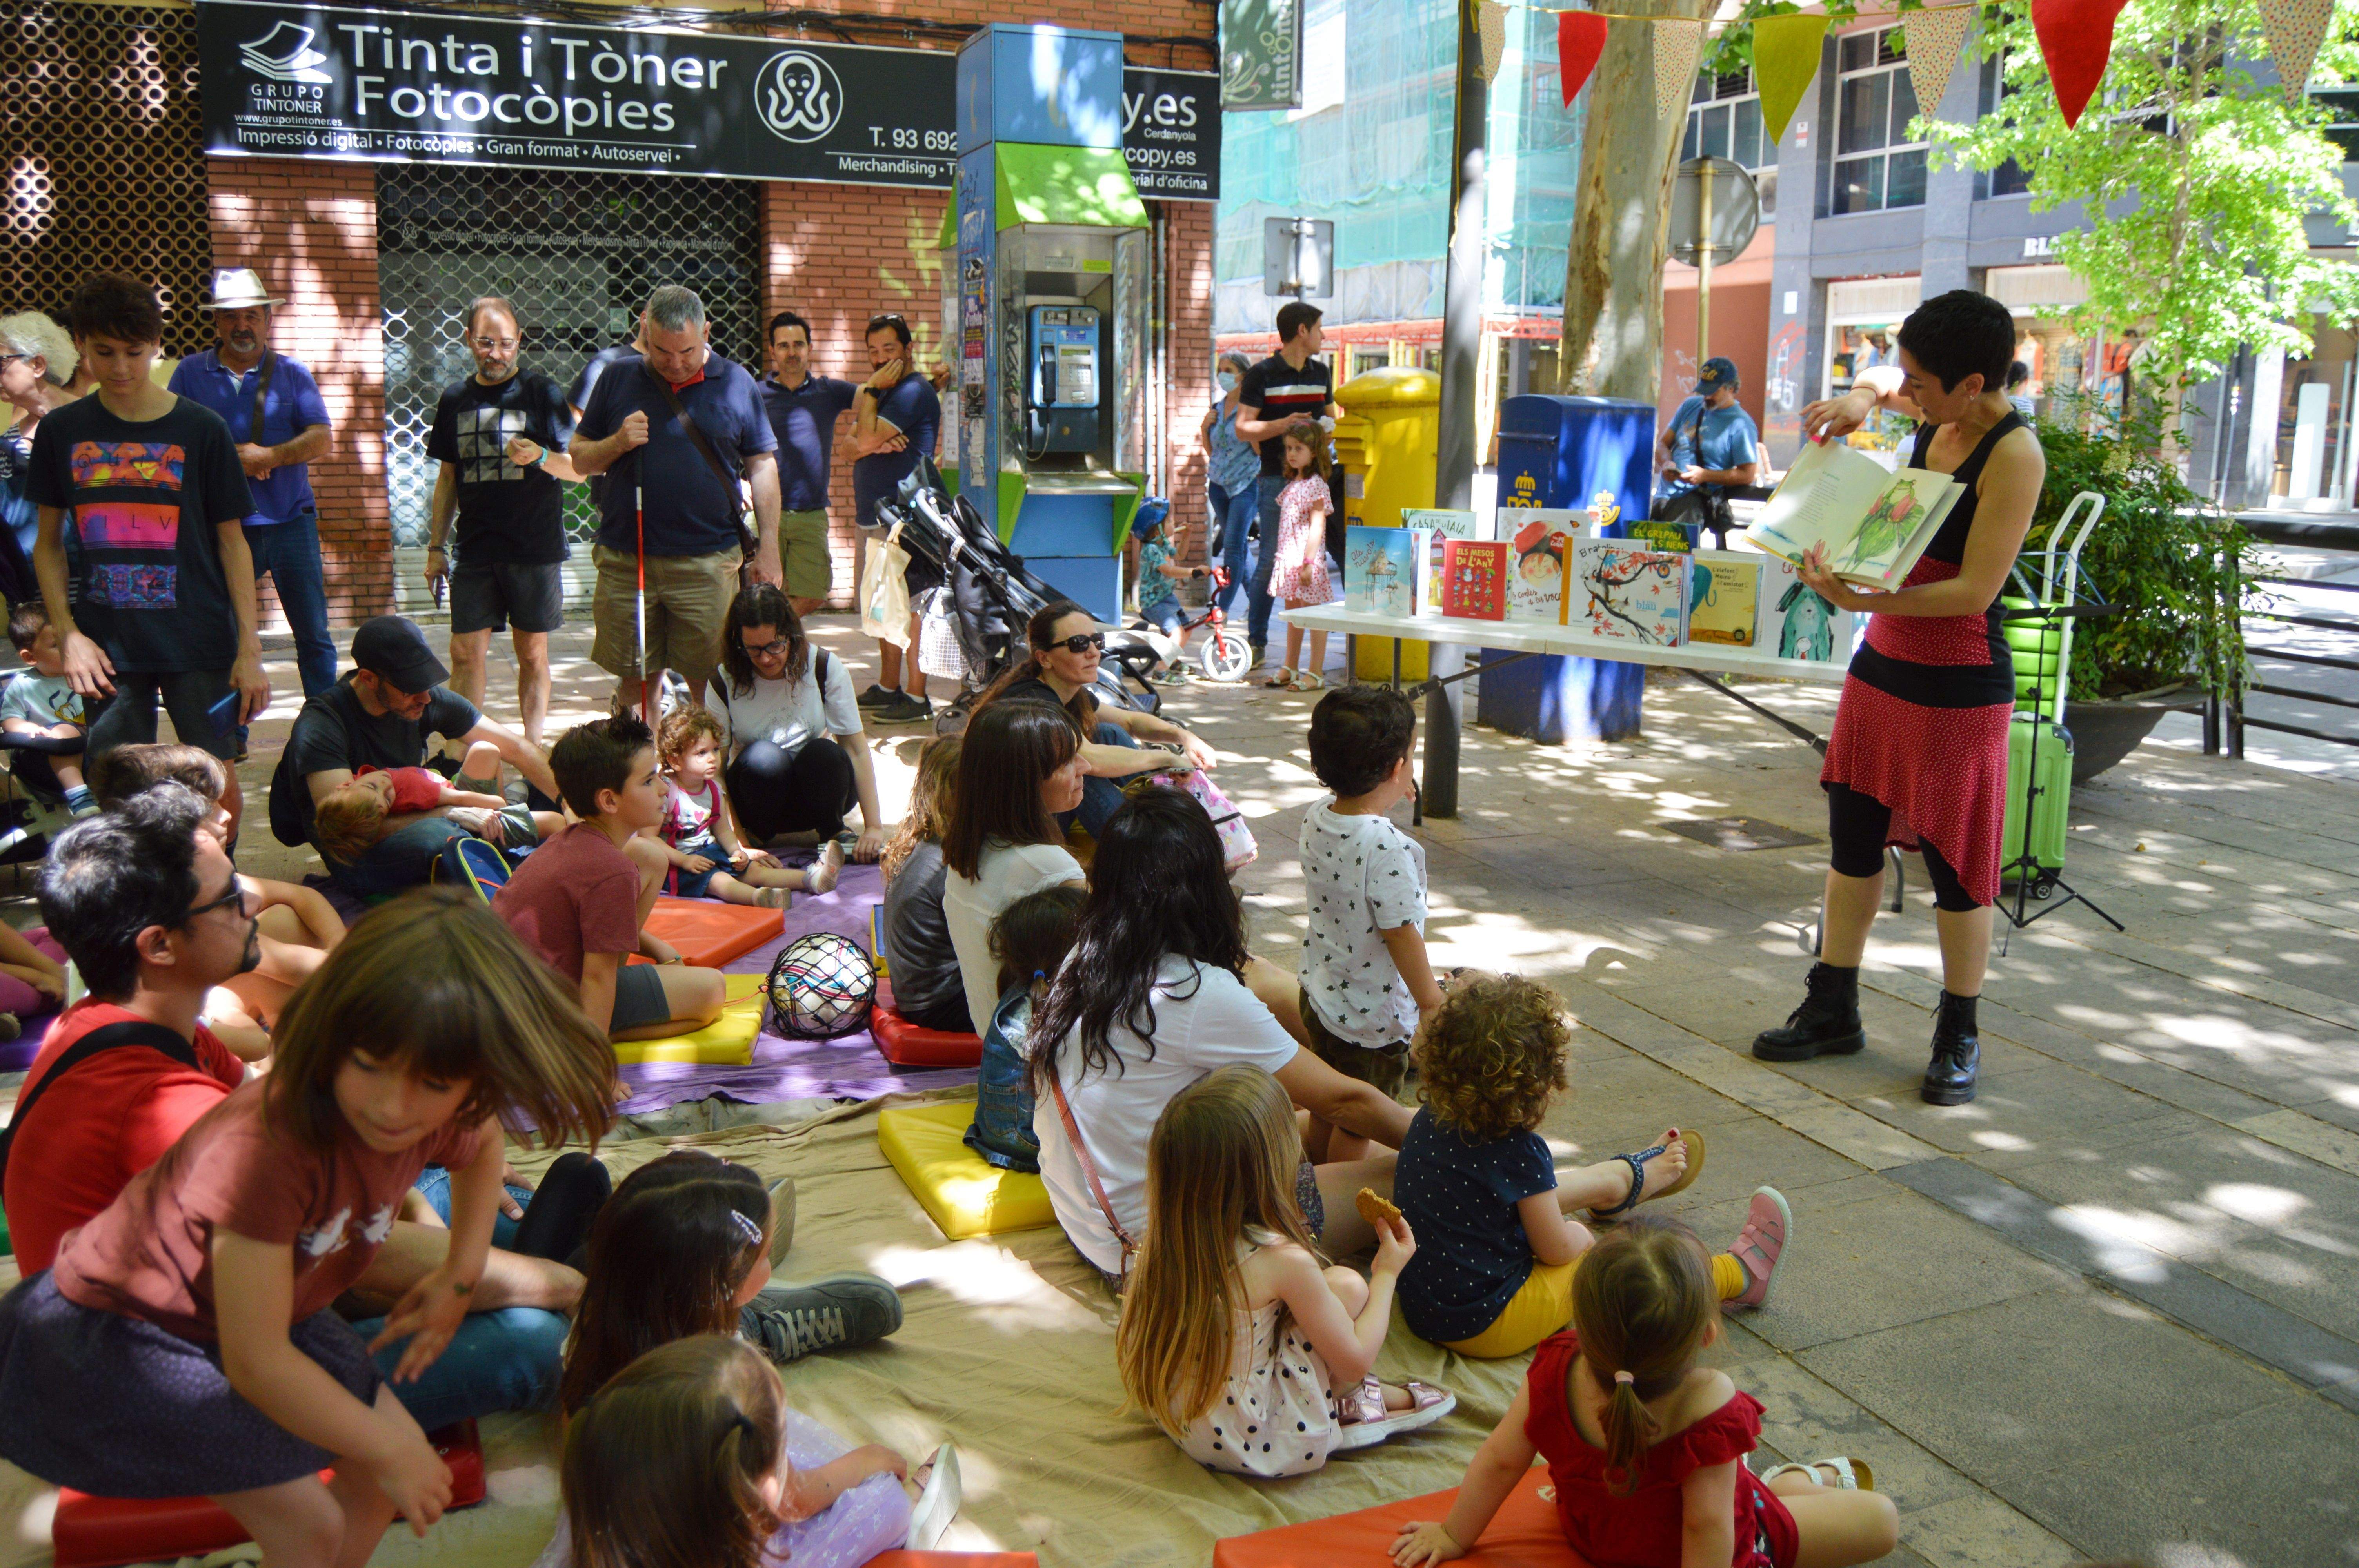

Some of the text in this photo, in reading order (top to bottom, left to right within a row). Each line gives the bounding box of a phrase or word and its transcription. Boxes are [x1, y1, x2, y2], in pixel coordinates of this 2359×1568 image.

[338, 24, 728, 89] Tinta i Tòner
[251, 84, 323, 99] GRUPO
[254, 98, 322, 114] TINTONER
[357, 76, 675, 136] Fotocòpies
[234, 114, 342, 127] www.grupotintoner.es
[869, 127, 885, 147] T.
[892, 129, 918, 148] 93
[1144, 128, 1196, 142] Cerdanyola
[238, 127, 671, 162] Impressió digital Fotocòpies Gran format Autoservei
[1123, 147, 1196, 169] copy.es
[839, 157, 936, 178] Merchandising
[1157, 174, 1207, 190] d'oficina
[1634, 528, 1681, 540] EL GRIPAU
[1470, 549, 1495, 557] MESOS
[1666, 541, 1689, 550] NENS
[1456, 556, 1467, 565] DE
